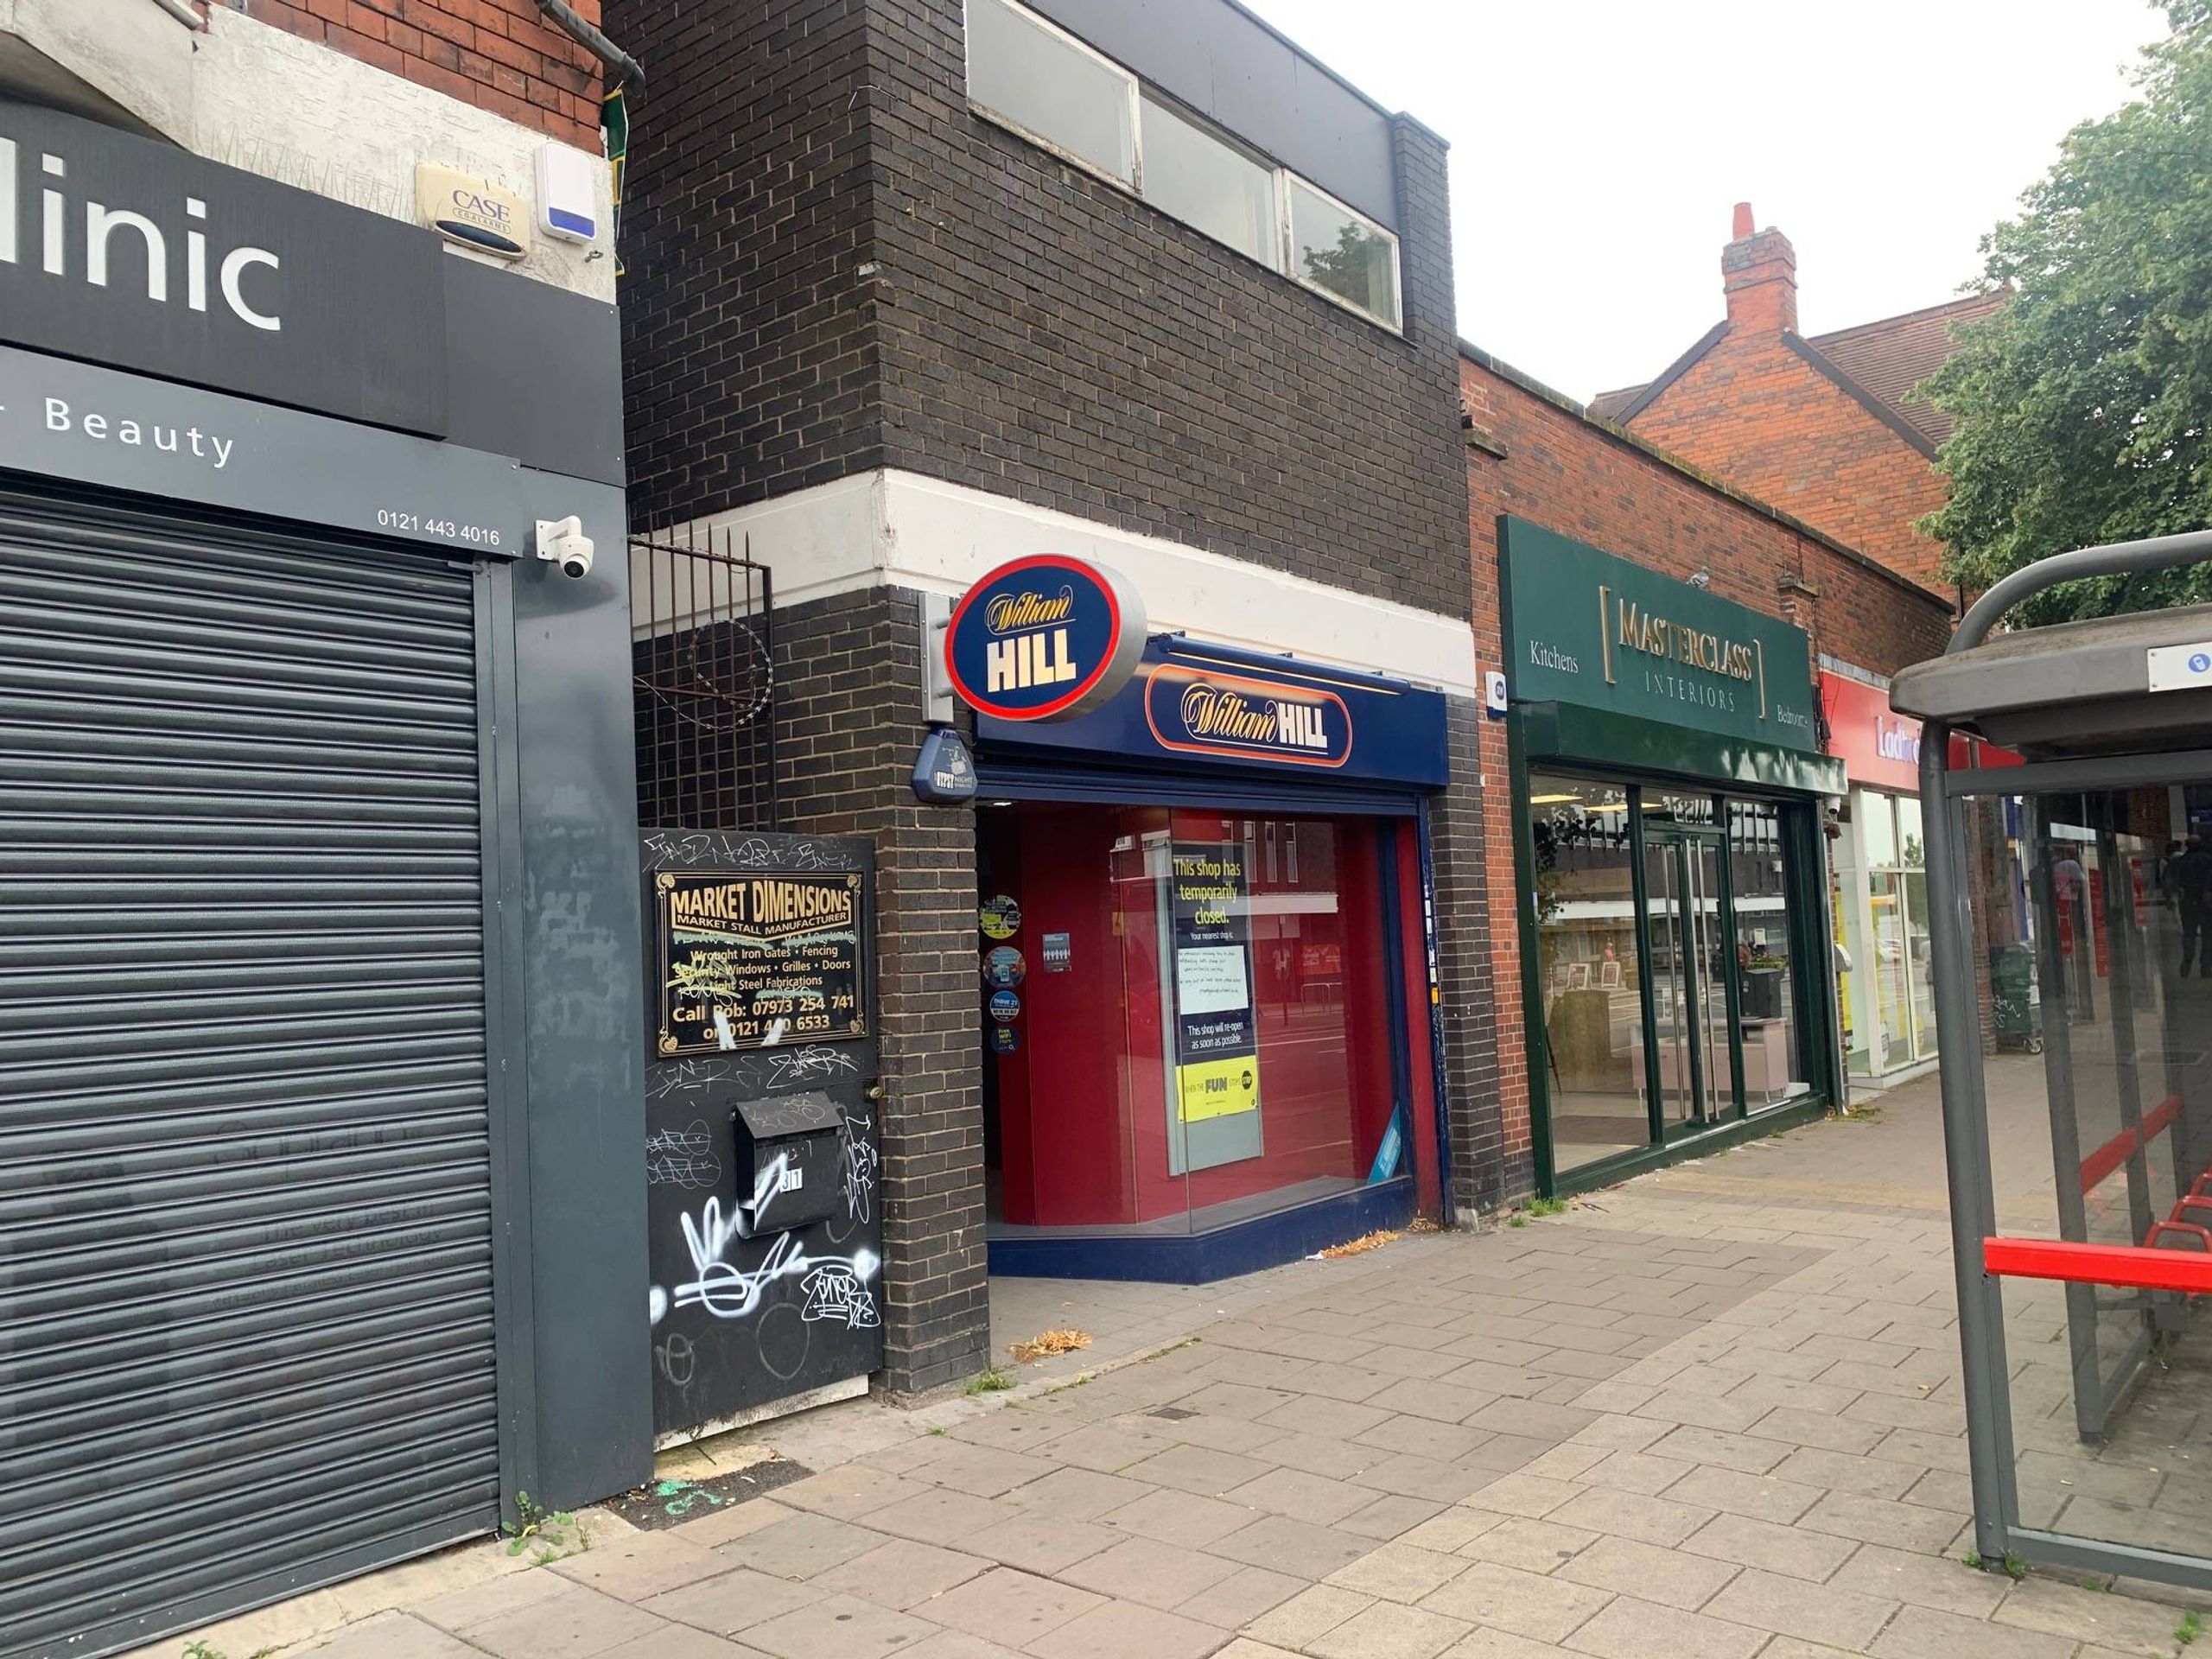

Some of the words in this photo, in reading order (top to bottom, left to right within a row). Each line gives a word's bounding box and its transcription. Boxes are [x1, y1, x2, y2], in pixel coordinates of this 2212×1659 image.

[453, 190, 511, 224] CASE
[0, 137, 281, 331] linic
[45, 397, 233, 468] Beauty
[378, 510, 417, 531] 0121
[425, 519, 455, 537] 443
[461, 525, 499, 545] 4016
[985, 585, 1074, 634] William
[1618, 598, 1752, 682] MASTERCLASS
[987, 629, 1077, 692] HILL
[1529, 640, 1579, 674] Kitchens
[1644, 670, 1736, 713] INTERIORS
[1181, 683, 1280, 744] William
[1278, 702, 1328, 748] HILL
[1173, 858, 1195, 876] This
[1197, 858, 1220, 880] shop
[1223, 858, 1242, 876] has
[671, 882, 747, 921] MARKET
[752, 880, 852, 924] DIMENSIONS
[1179, 882, 1237, 904] temporarily
[677, 914, 727, 930] MARKET
[731, 922, 762, 935] STALL
[765, 911, 848, 935] MANUFACTURER
[1194, 906, 1230, 925] closed.
[690, 949, 739, 963] Wrought
[741, 949, 761, 959] Iron
[764, 947, 791, 958] Gates
[802, 945, 838, 958] Fencing
[725, 963, 772, 976] Windows
[782, 961, 810, 972] Grilles
[823, 959, 851, 970] Doors
[739, 978, 763, 990] Steel
[766, 976, 823, 989] Fabrications
[672, 1005, 706, 1022] Call
[752, 999, 793, 1016] 07973
[799, 996, 826, 1012] 254
[831, 994, 855, 1009] 741
[728, 1020, 760, 1037] 0121
[764, 1019, 791, 1033] 40
[797, 1014, 830, 1031] 6533
[1187, 1024, 1201, 1036] This
[1205, 1076, 1228, 1094] FUN
